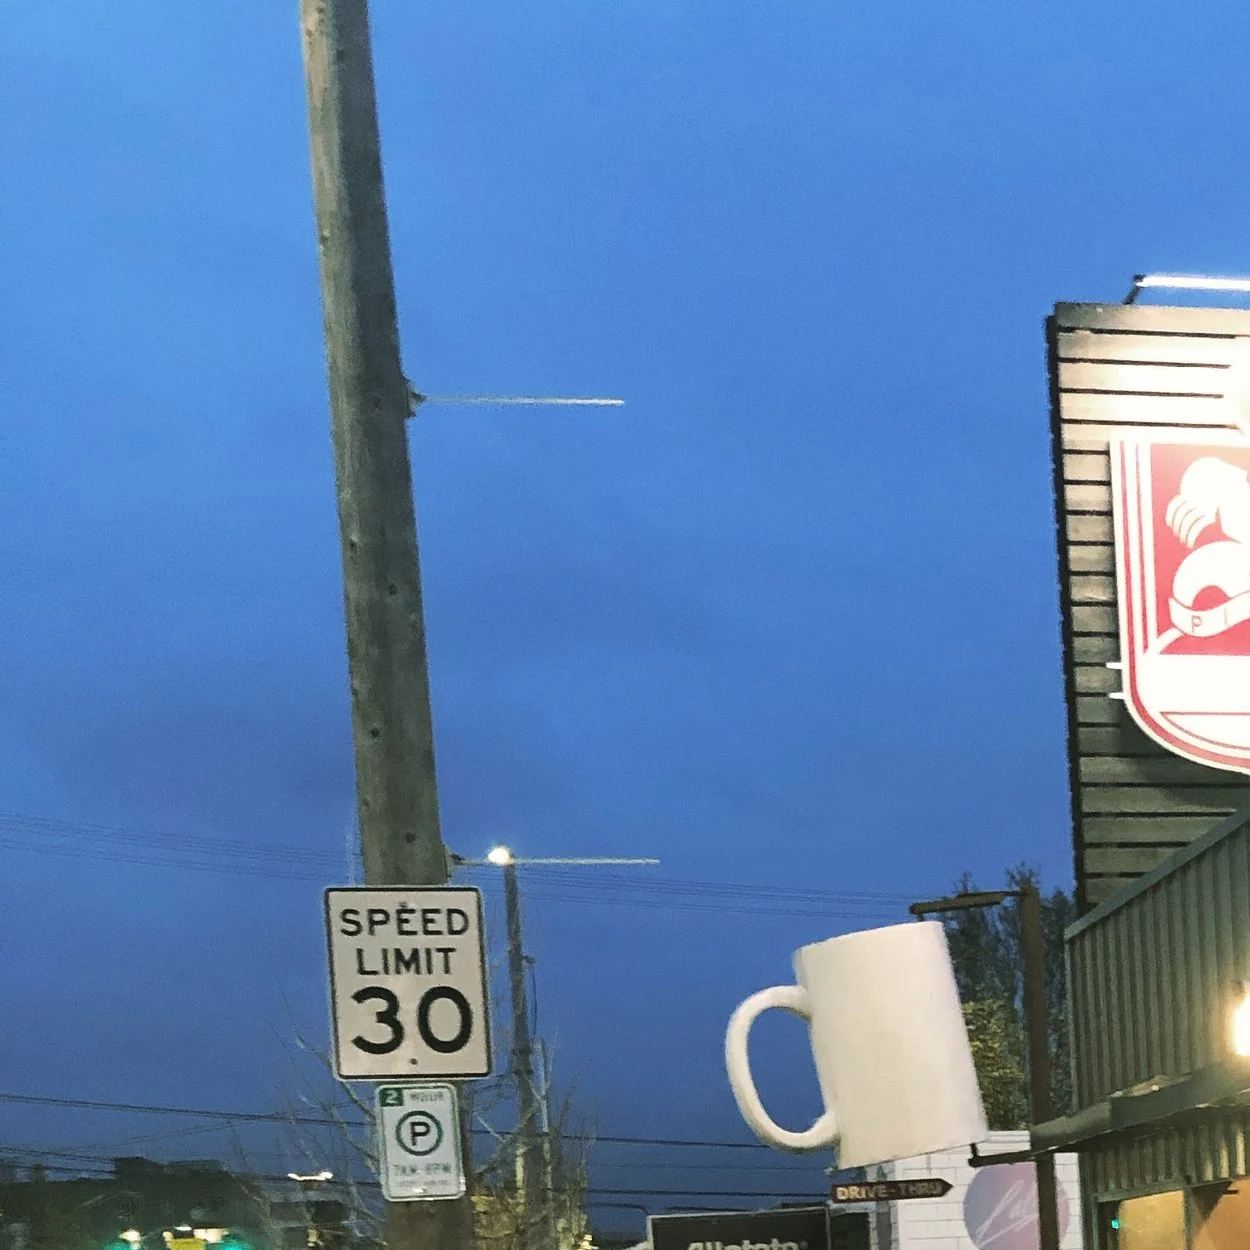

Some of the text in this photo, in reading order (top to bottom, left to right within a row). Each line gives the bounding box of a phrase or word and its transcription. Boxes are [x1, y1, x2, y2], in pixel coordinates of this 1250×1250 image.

[340, 908, 470, 937] SPEED
[356, 947, 456, 976] LIMIT
[351, 985, 473, 1055] 30
[385, 1089, 400, 1104] 2
[410, 1121, 431, 1146] P
